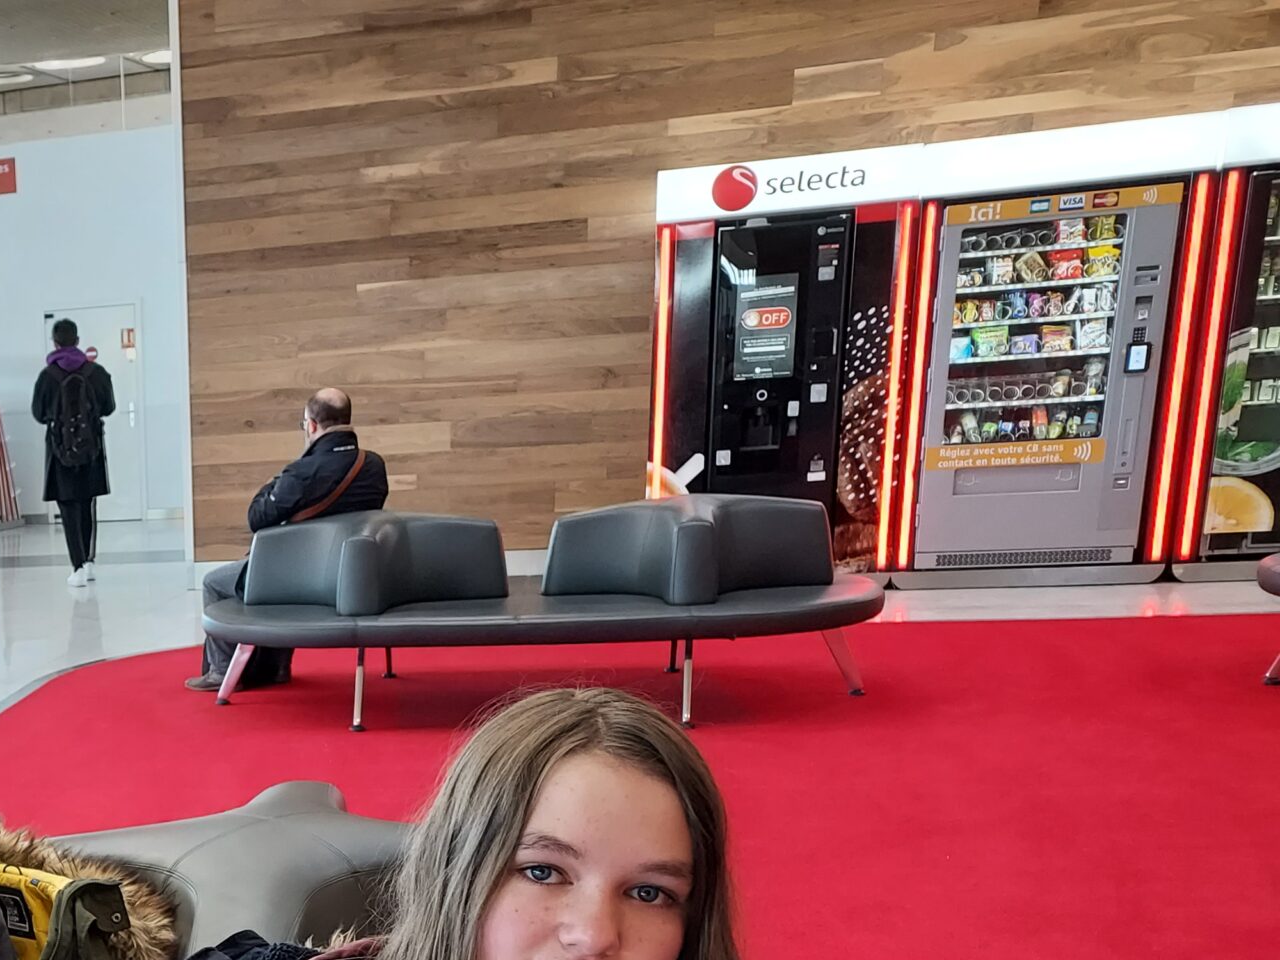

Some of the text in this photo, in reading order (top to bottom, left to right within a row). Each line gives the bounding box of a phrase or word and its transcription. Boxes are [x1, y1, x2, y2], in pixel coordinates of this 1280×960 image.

[765, 165, 866, 195] selecta
[1062, 197, 1083, 206] VISA
[968, 203, 1001, 222] Ici!
[761, 312, 788, 325] OFF
[940, 443, 1064, 458] Réglez avec votre CB sans
[938, 453, 1063, 468] contact en toute sécurité.
